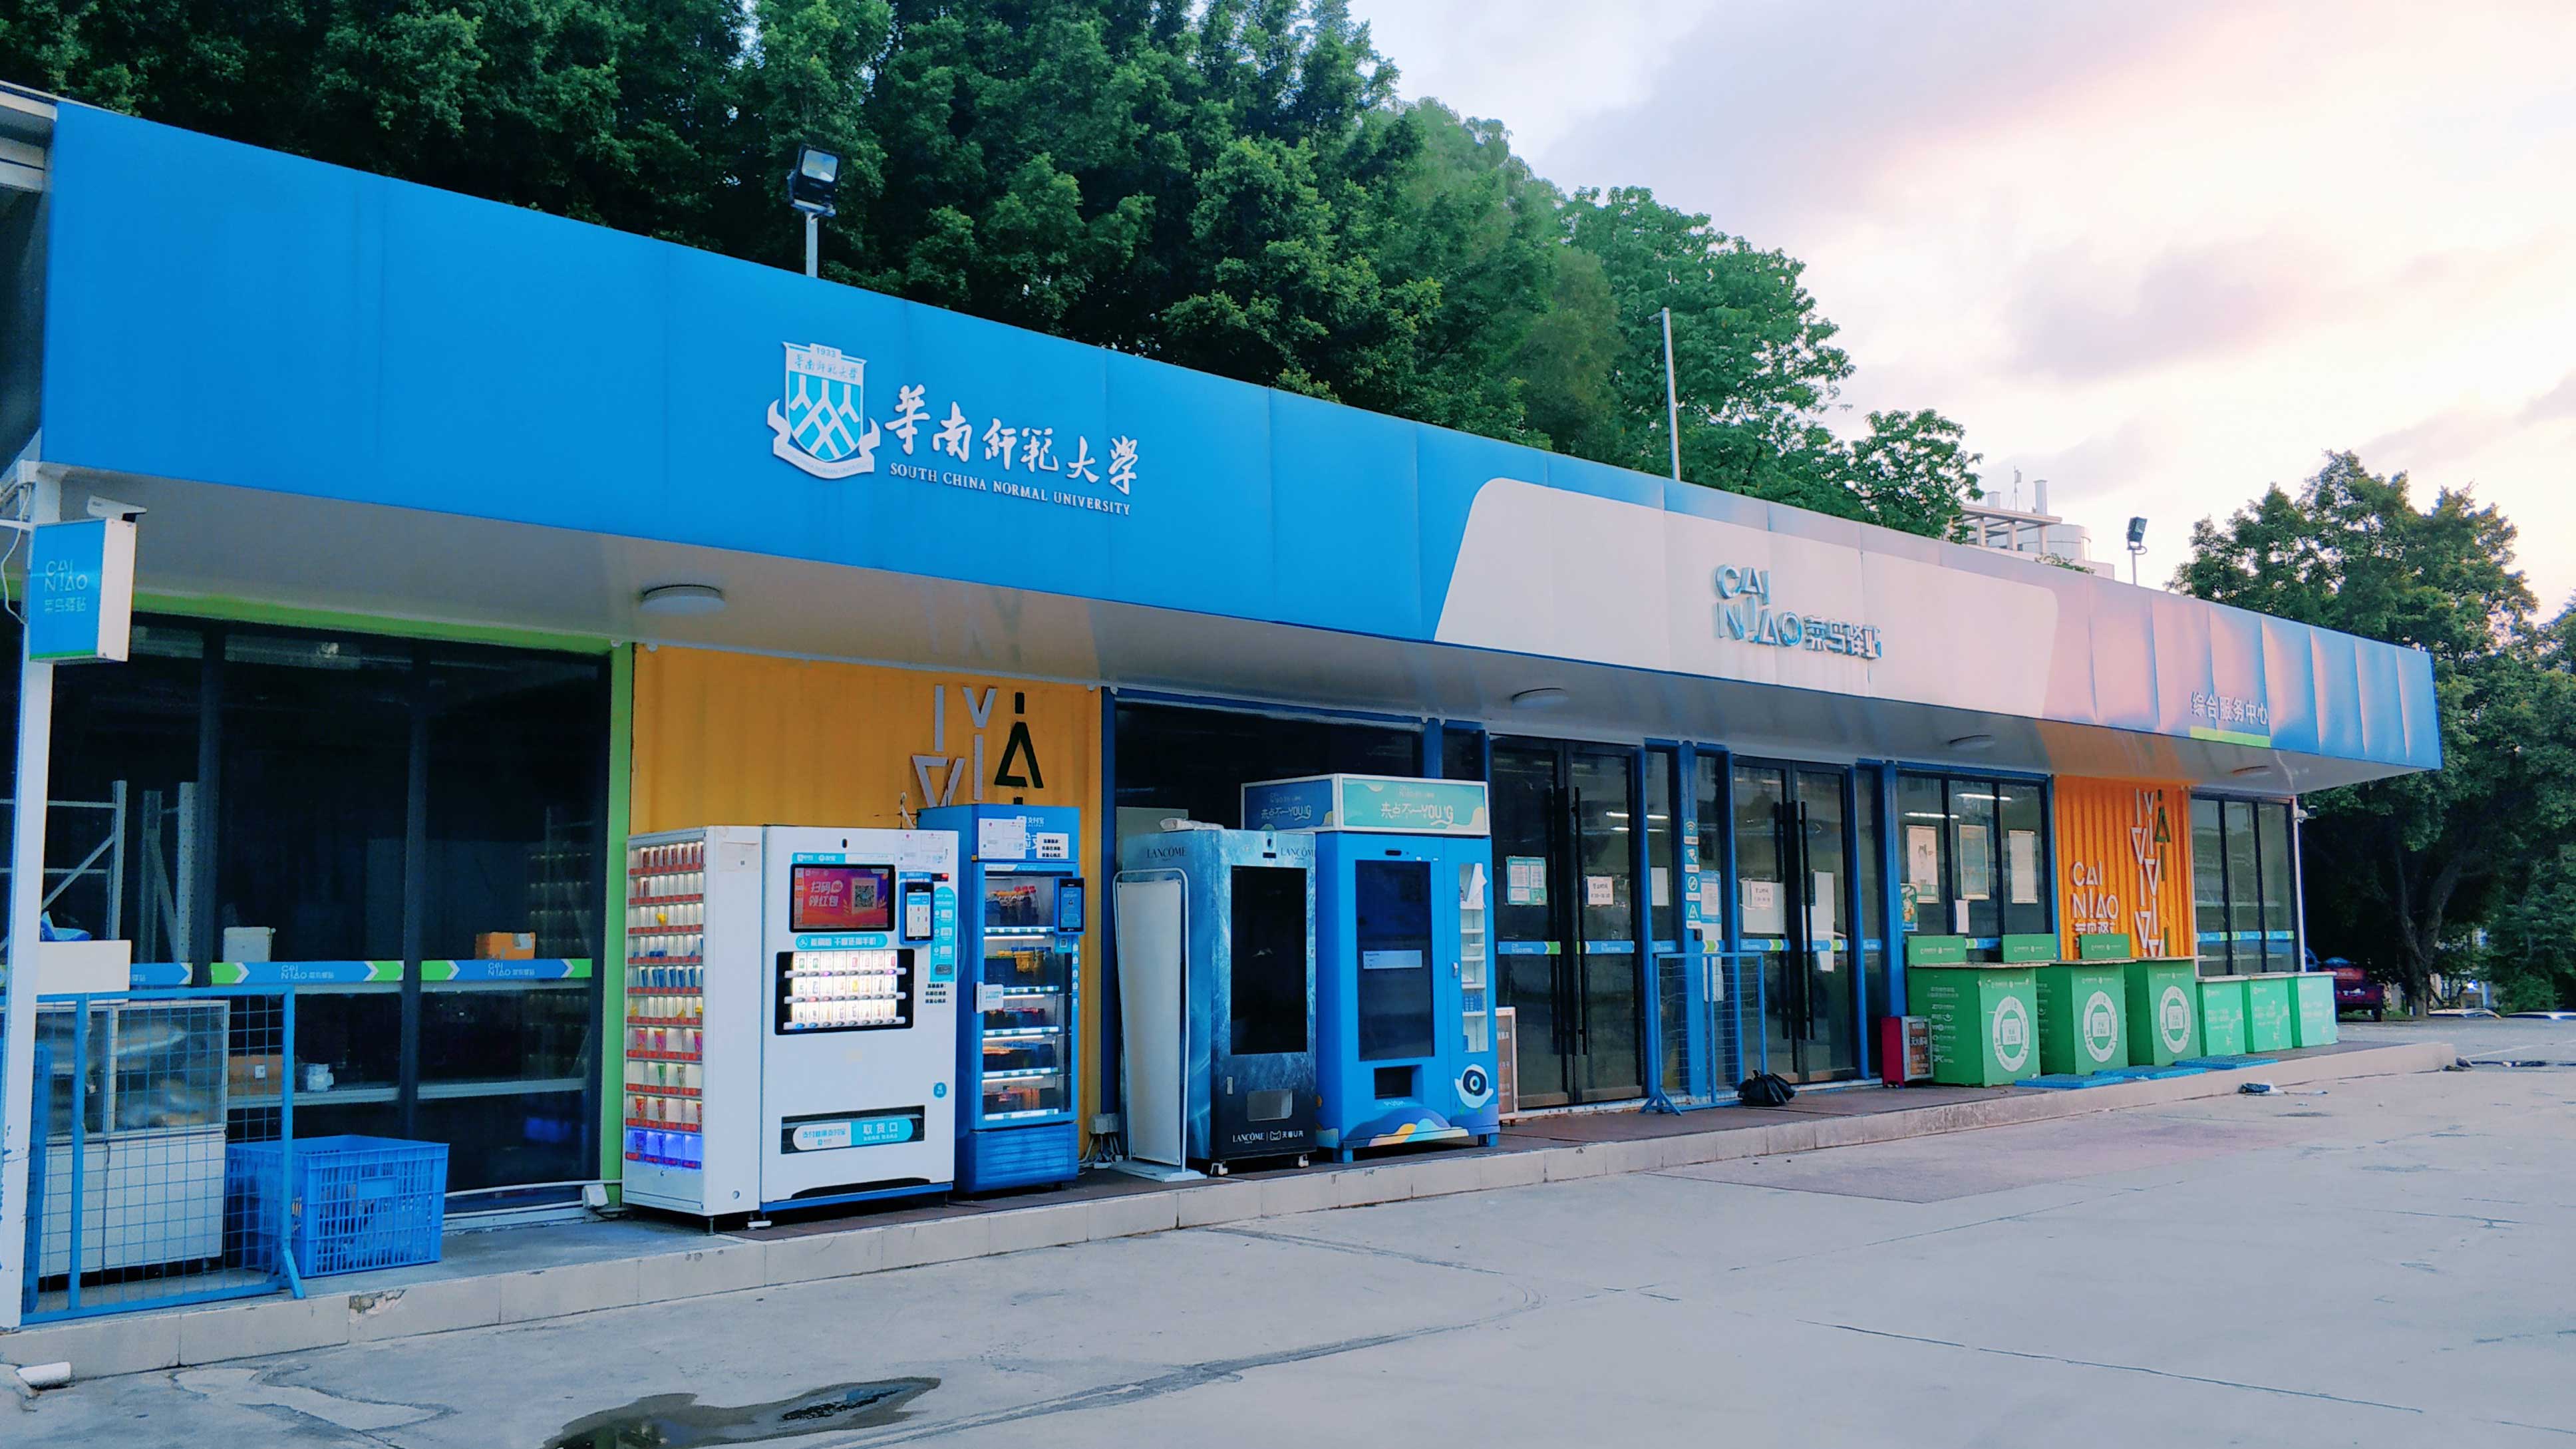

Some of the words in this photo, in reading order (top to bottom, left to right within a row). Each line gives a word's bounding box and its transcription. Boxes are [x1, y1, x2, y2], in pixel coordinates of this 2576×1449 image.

[816, 347, 836, 358] 1933
[890, 462, 937, 484] SOUTH
[942, 472, 987, 491] CHINA
[993, 480, 1048, 502] NORMAL
[1053, 492, 1131, 516] UNIVERSITY
[45, 573, 88, 591] NIAO
[46, 560, 73, 577] CAI
[1714, 564, 1771, 604] CAI
[1715, 597, 1802, 647] NIAO
[2191, 691, 2268, 725] 综合服务中心
[1280, 846, 1316, 858] LANCÔM
[2072, 860, 2103, 887] CAI
[2072, 888, 2120, 919] NIAO
[864, 1123, 897, 1134] 取货口
